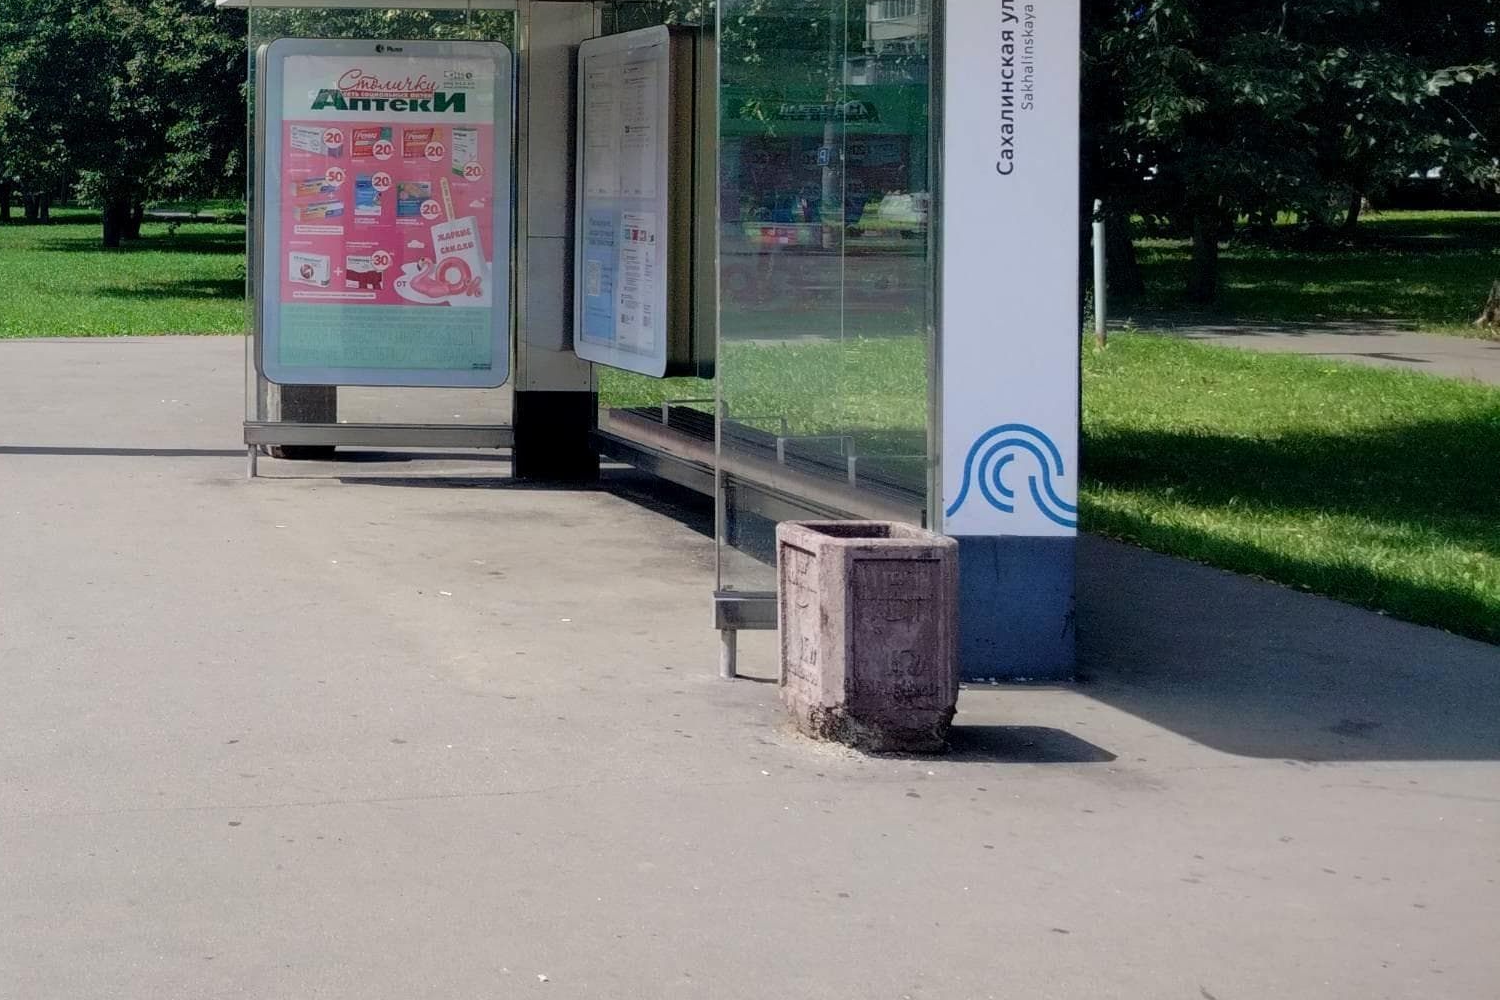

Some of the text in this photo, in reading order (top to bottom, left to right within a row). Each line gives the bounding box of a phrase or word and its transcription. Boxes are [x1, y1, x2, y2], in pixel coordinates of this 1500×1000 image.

[338, 68, 439, 91] Столички
[996, 29, 1015, 175] Сахалинская
[1021, 4, 1036, 110] Sakhalinskaya
